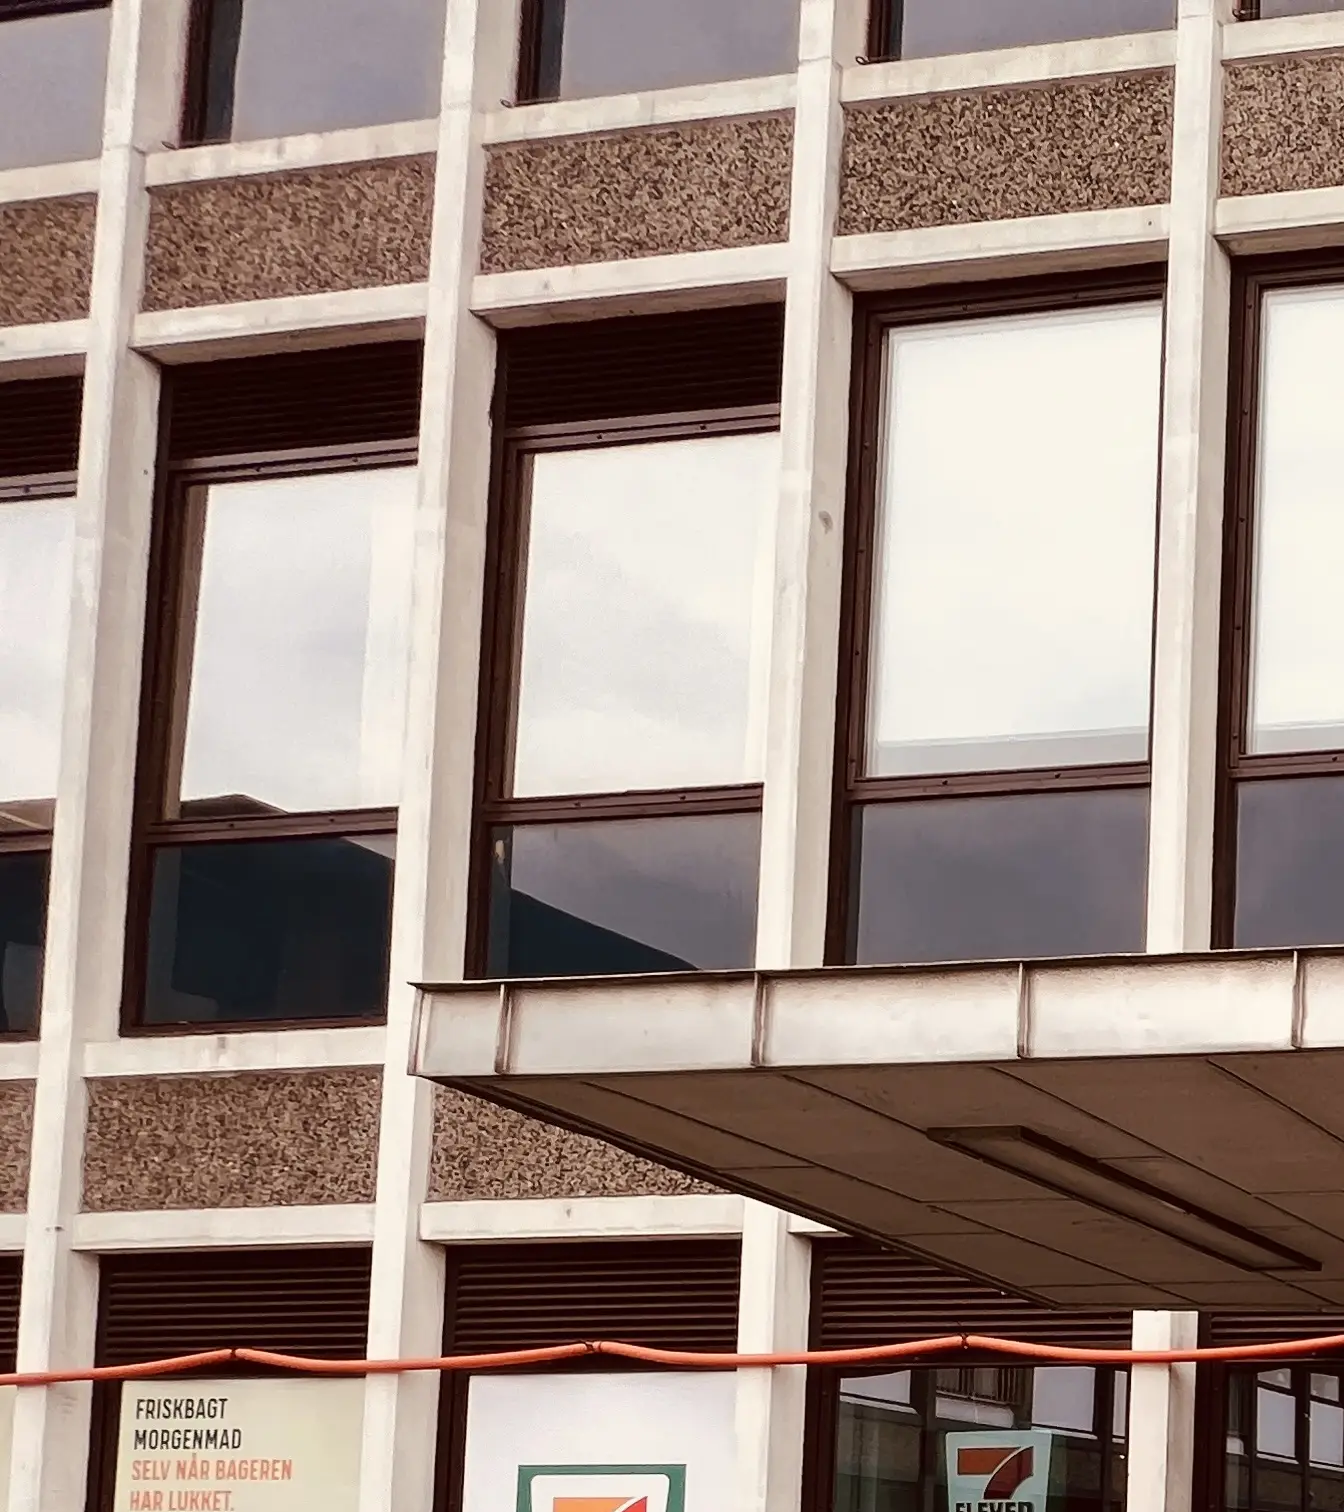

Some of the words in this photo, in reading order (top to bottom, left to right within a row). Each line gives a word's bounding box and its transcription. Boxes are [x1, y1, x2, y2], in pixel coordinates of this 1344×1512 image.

[136, 1398, 228, 1419] FRISKBAGT
[133, 1428, 242, 1450] MORGENMAD
[131, 1459, 171, 1481] SELV
[176, 1452, 210, 1481] NÅR
[215, 1459, 292, 1480] BAGEREN
[129, 1490, 163, 1511] HAR
[168, 1490, 234, 1511] LUKKET.
